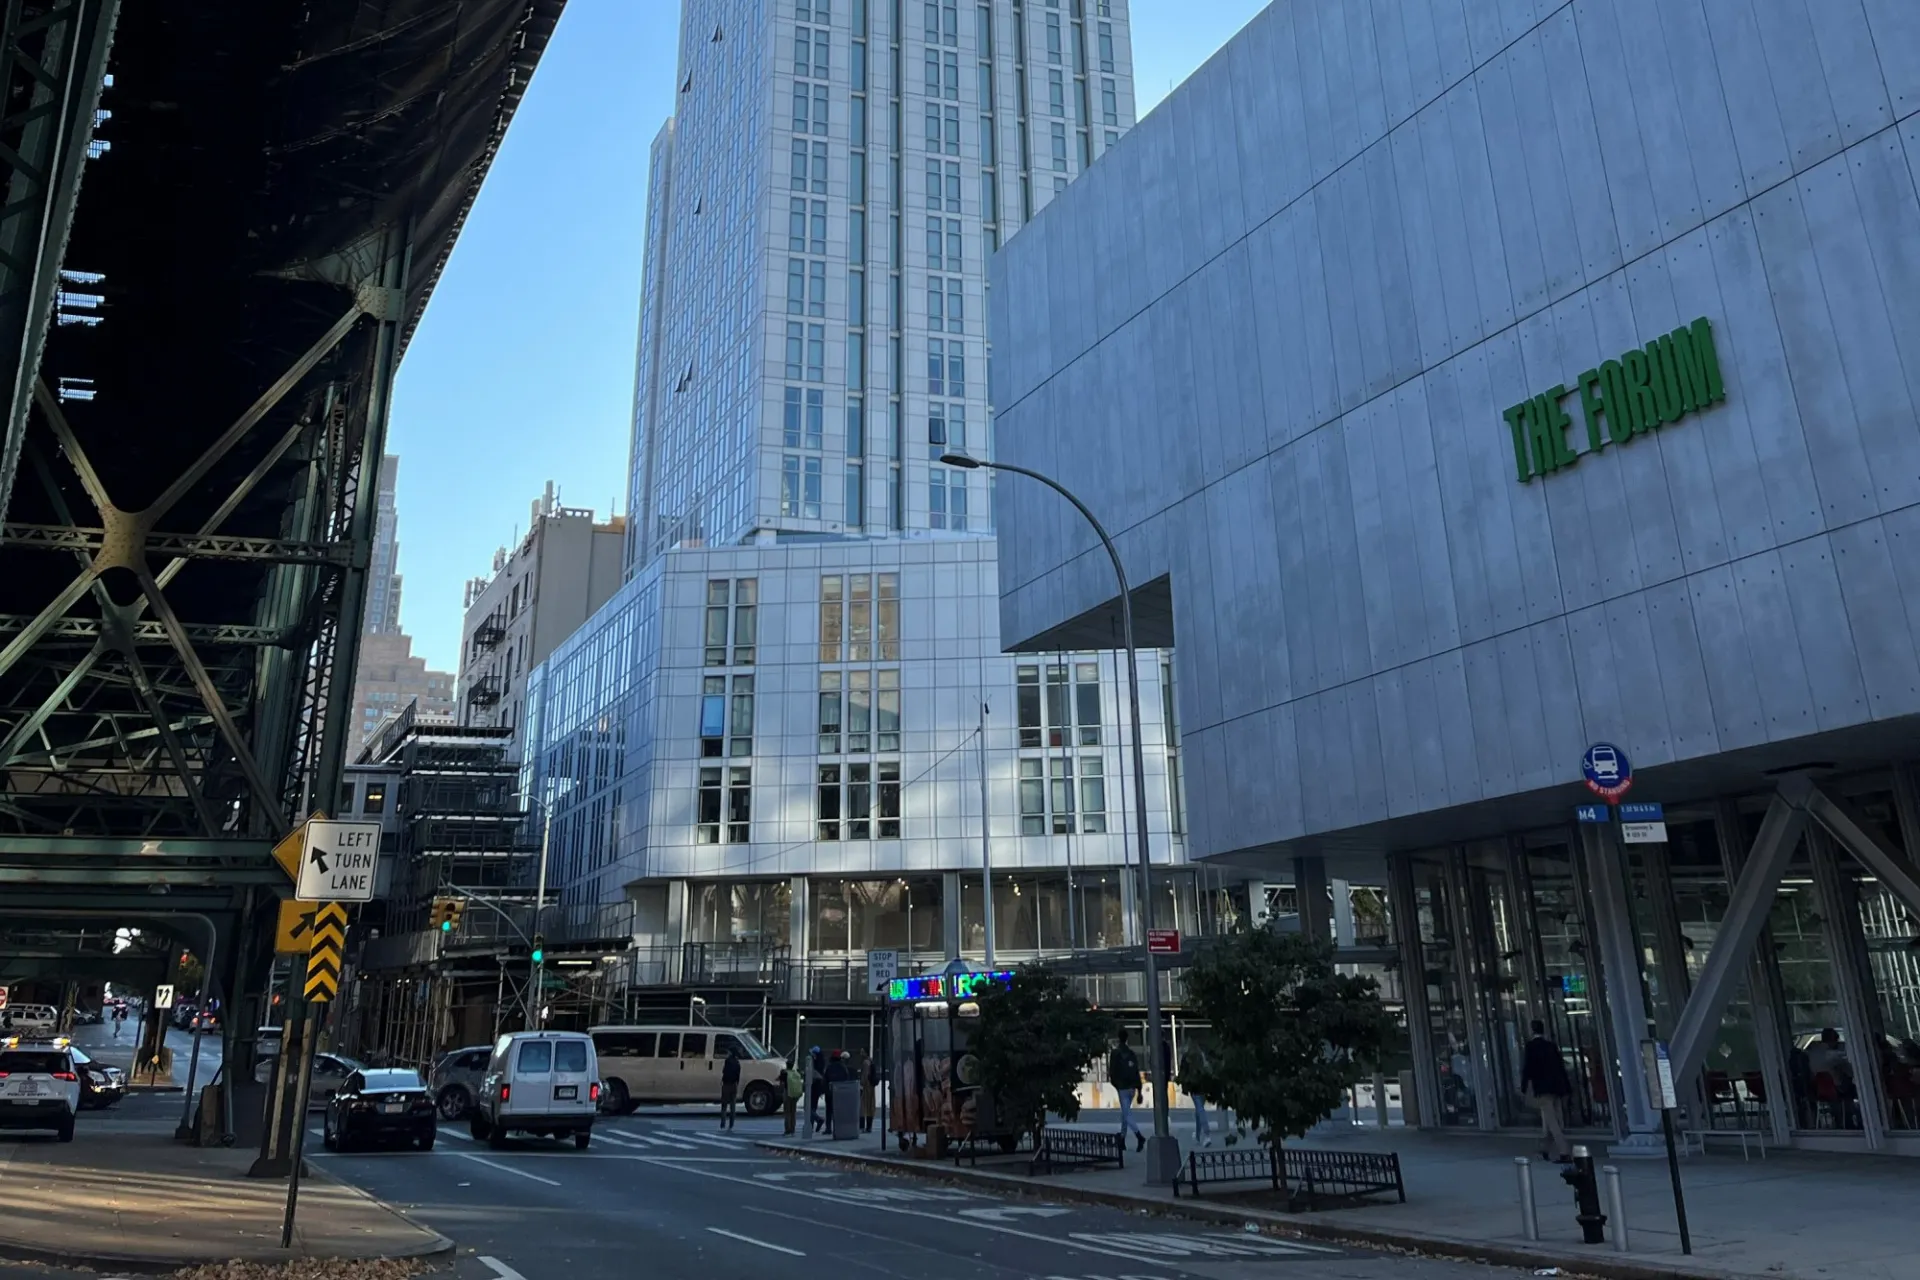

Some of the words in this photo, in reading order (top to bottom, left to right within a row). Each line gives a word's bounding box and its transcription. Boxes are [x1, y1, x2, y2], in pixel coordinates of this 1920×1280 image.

[1503, 383, 1577, 482] THE
[1578, 316, 1726, 453] FORUM
[1599, 779, 1631, 795] STANDING
[1579, 807, 1597, 820] M4
[338, 832, 373, 847] LEFT
[335, 853, 372, 868] TURN
[331, 875, 367, 890] LANE
[873, 952, 892, 960] STOP
[875, 969, 890, 978] RED
[1069, 1232, 1344, 1256] ONLY
